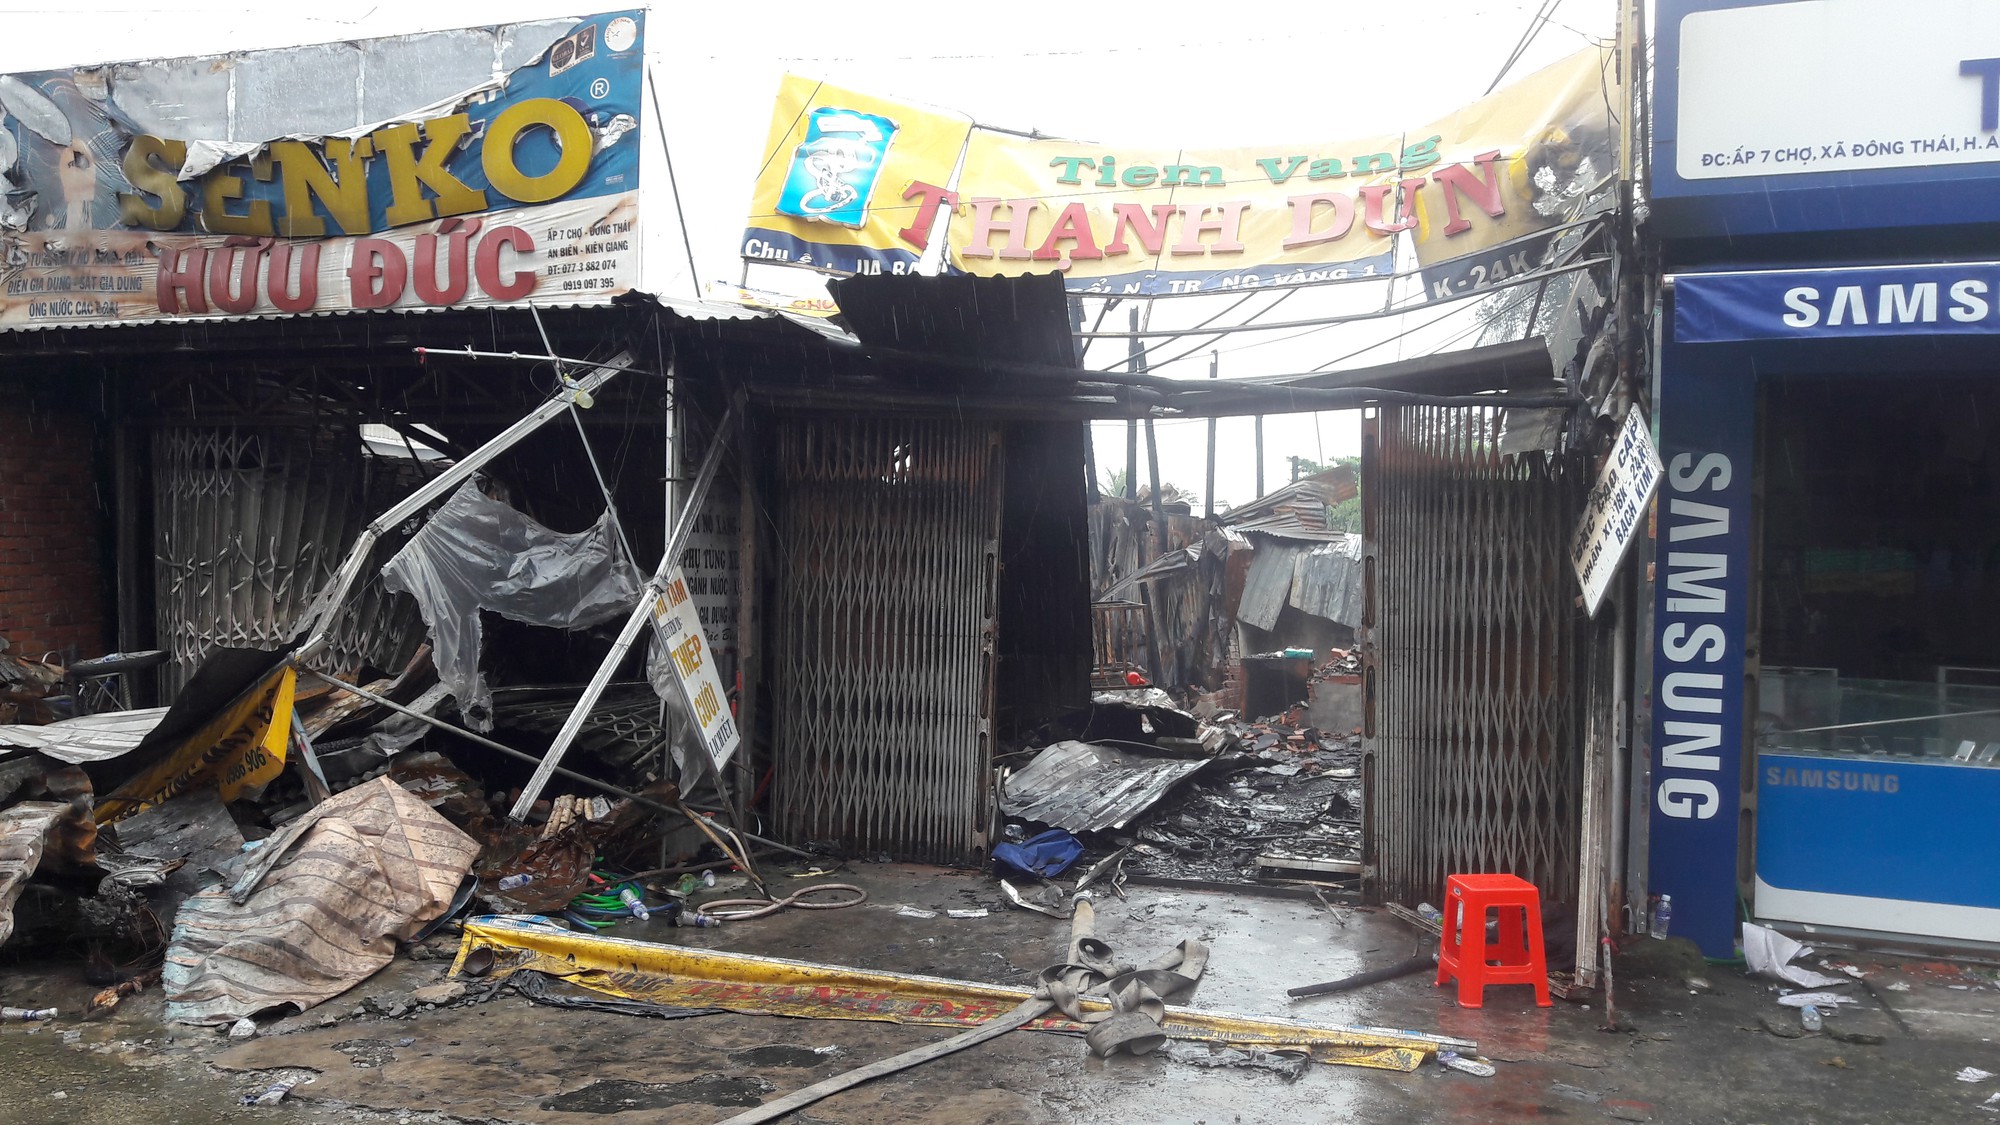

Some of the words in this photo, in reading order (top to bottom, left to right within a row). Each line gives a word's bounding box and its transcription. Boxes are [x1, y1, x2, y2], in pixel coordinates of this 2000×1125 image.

[118, 97, 594, 237] SENKO
[1051, 154, 1224, 188] Tiem
[1255, 134, 1442, 188] Vang
[1761, 150, 1770, 163] 7
[1774, 146, 1817, 165] CHỢ,
[1820, 140, 1847, 159] XÃ
[1851, 139, 1904, 158] ĐÔNG
[1910, 134, 1960, 154] THÁI,
[547, 227, 558, 242] ẤP
[560, 229, 564, 240] 7
[566, 226, 583, 241] CHỢ
[613, 219, 631, 233] THÁI
[547, 248, 558, 259] AN
[560, 243, 579, 258] BIÊN
[585, 241, 604, 255] KIÊN
[605, 240, 629, 253] GIANG
[156, 235, 322, 315] HỮU
[346, 217, 538, 309] ĐỨC
[547, 265, 560, 276] ĐT:
[562, 263, 576, 275] 077
[579, 262, 583, 272] 3
[585, 260, 600, 272] 882
[601, 259, 616, 271] 074
[563, 279, 582, 291] 0919
[583, 278, 598, 290] 097
[600, 277, 615, 289] 395
[1781, 279, 2000, 329] SAMS
[1634, 464, 1654, 503] KIM
[1657, 452, 1733, 820] SAMSUNG
[671, 632, 703, 681] THIỆP
[693, 680, 721, 730] CƯỚI
[245, 746, 268, 773] 906
[1766, 765, 1900, 794] SAMSUNG
